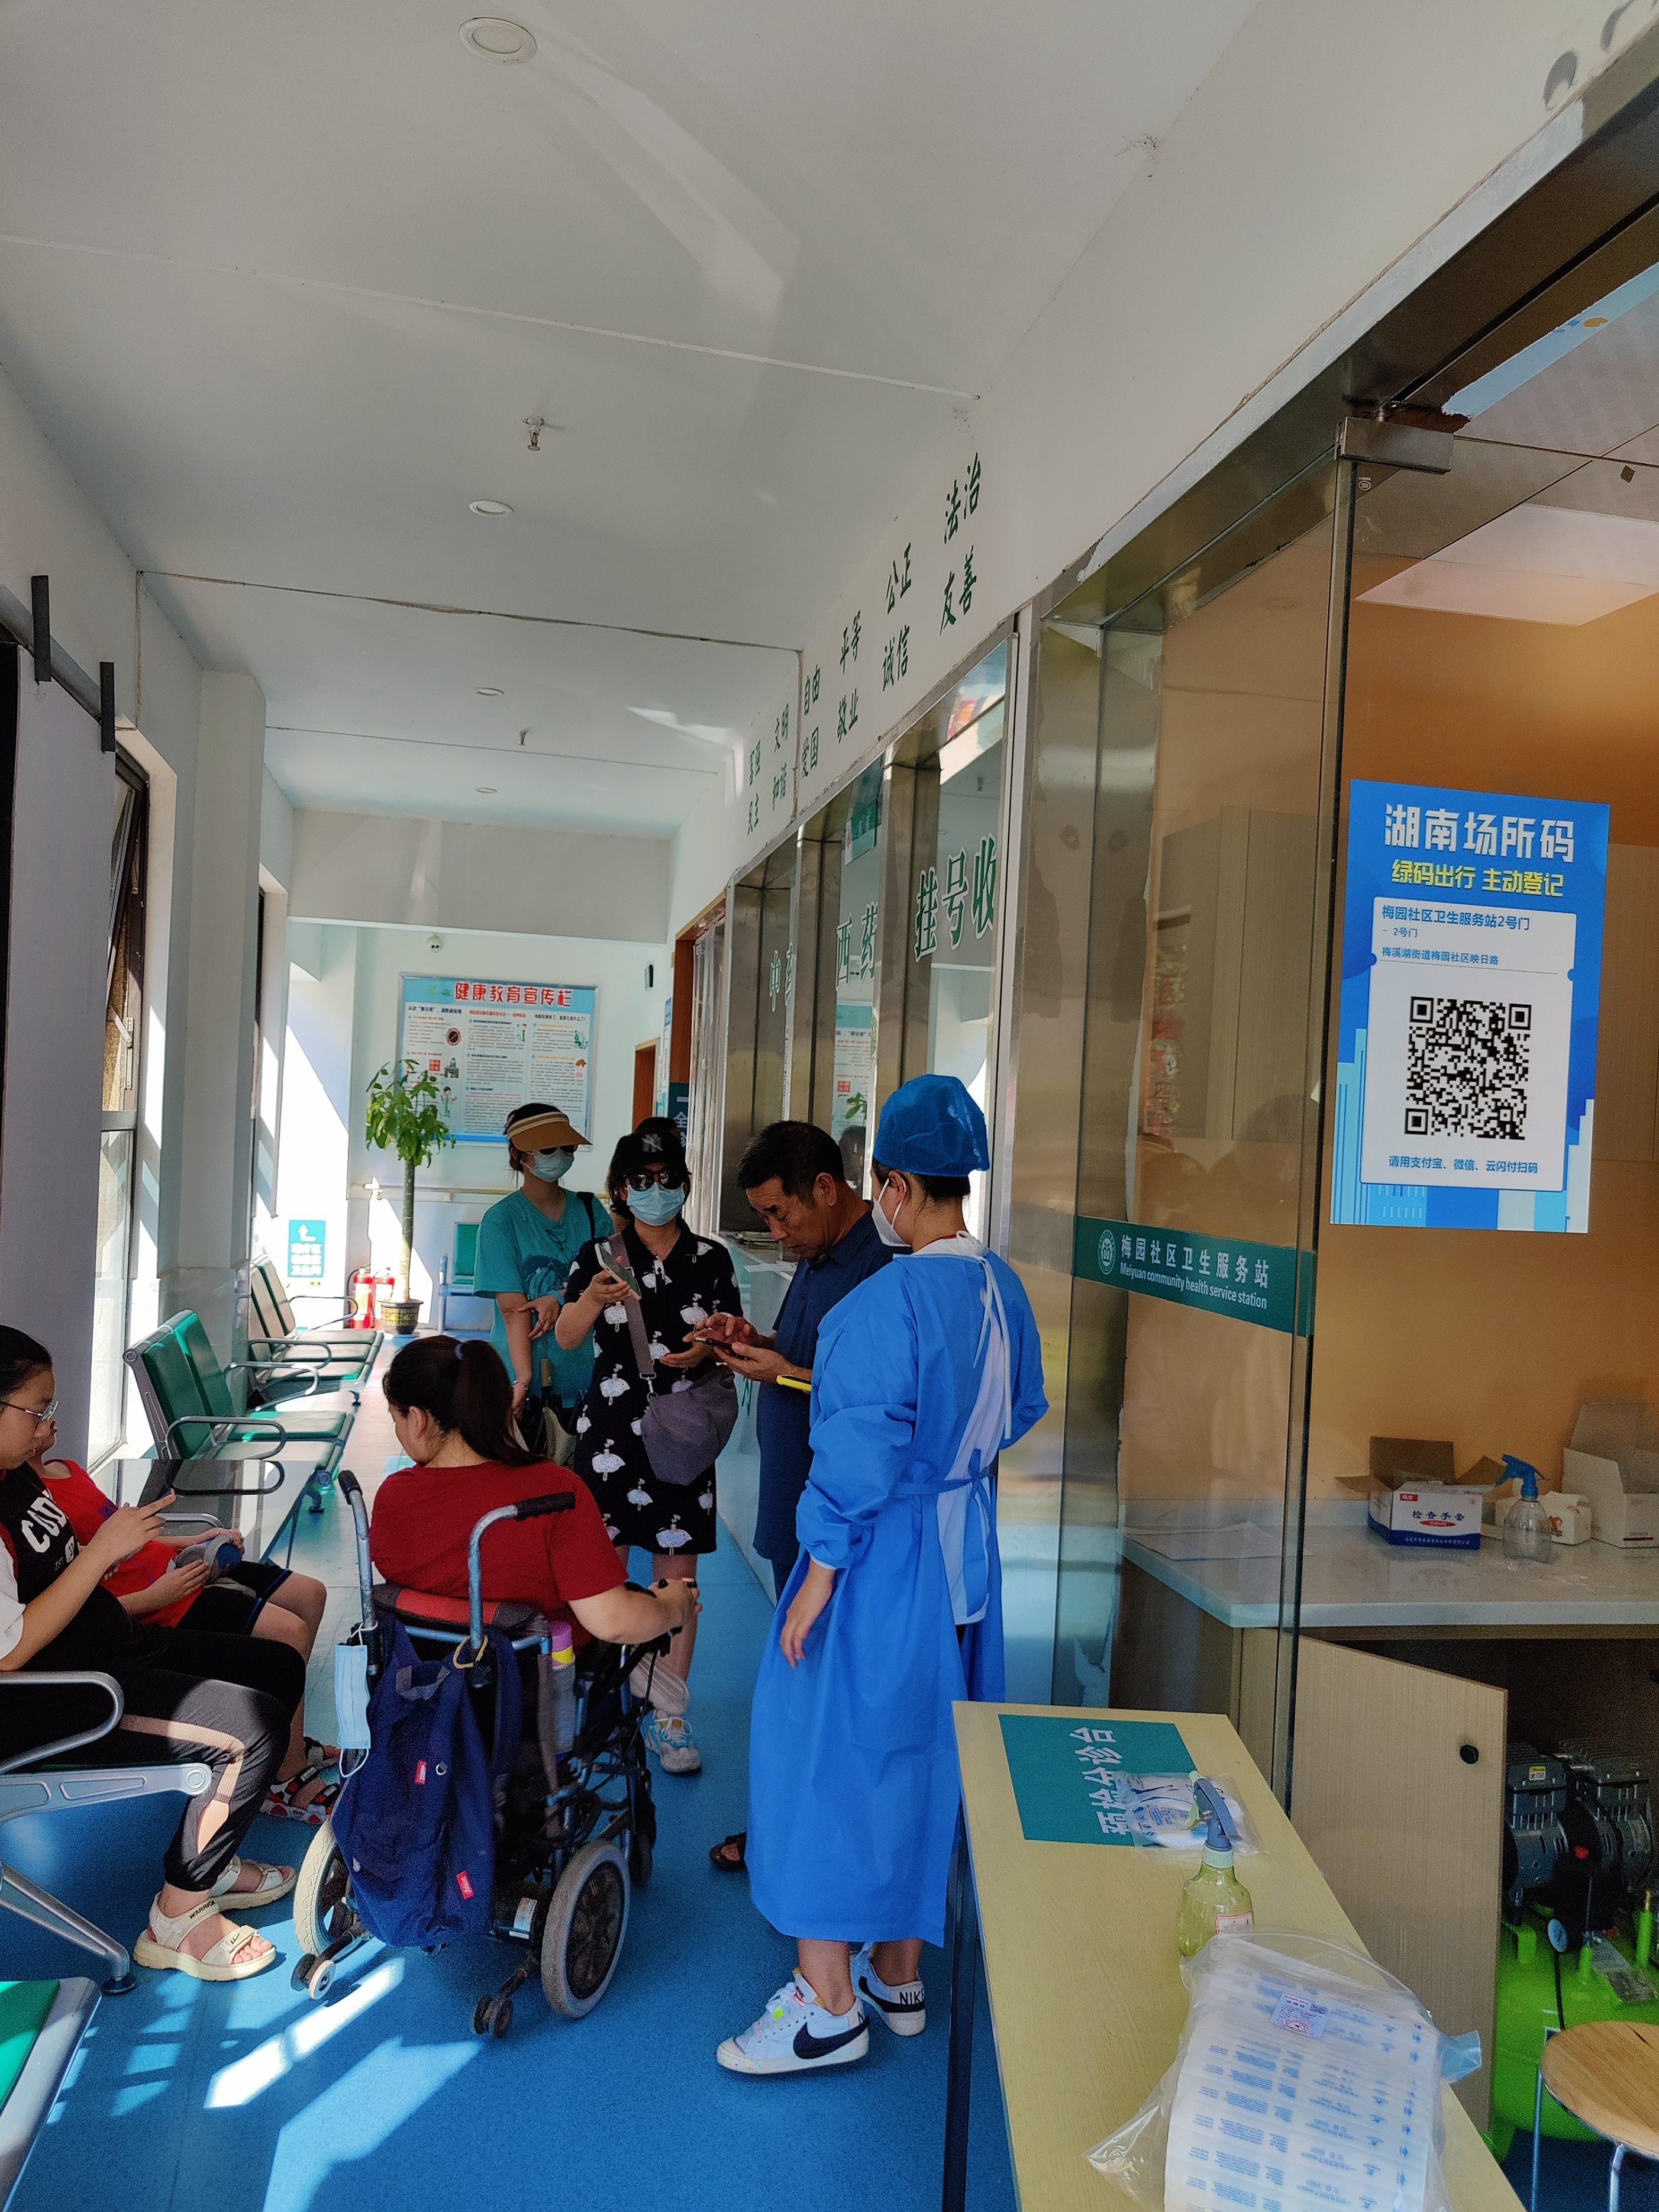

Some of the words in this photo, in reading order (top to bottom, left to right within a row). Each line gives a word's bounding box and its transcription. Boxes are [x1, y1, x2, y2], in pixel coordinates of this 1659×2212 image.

[773, 702, 789, 754] 文明
[803, 664, 820, 716] 自由
[840, 610, 861, 676] 平等
[886, 542, 911, 614] 公正
[944, 452, 981, 544] 法治
[802, 726, 819, 778] 爱国
[836, 687, 859, 744] 敬业
[883, 624, 909, 692] 诚信
[940, 544, 977, 636] 友善
[1384, 802, 1575, 863] 湖南场所码
[1391, 859, 1476, 890] 绿码出行
[1482, 868, 1565, 898] 主动登记
[1382, 905, 1529, 931] 梅园社区卫生服务站2号门
[1382, 946, 1499, 966] 梅溪湖街道梅园社区映日路
[454, 981, 573, 1007] 健康教育宣传栏
[1389, 1155, 1538, 1174] 请用支付宝、微信、云闪付扫码
[1121, 1234, 1269, 1289] 梅园社区卫生服务站
[1119, 1262, 1146, 1281] Meiyuan
[1147, 1271, 1184, 1291] community
[1185, 1277, 1208, 1295] health
[1209, 1285, 1237, 1302] service
[1237, 1292, 1267, 1310] station
[1412, 1510, 1465, 1521] 检查手套
